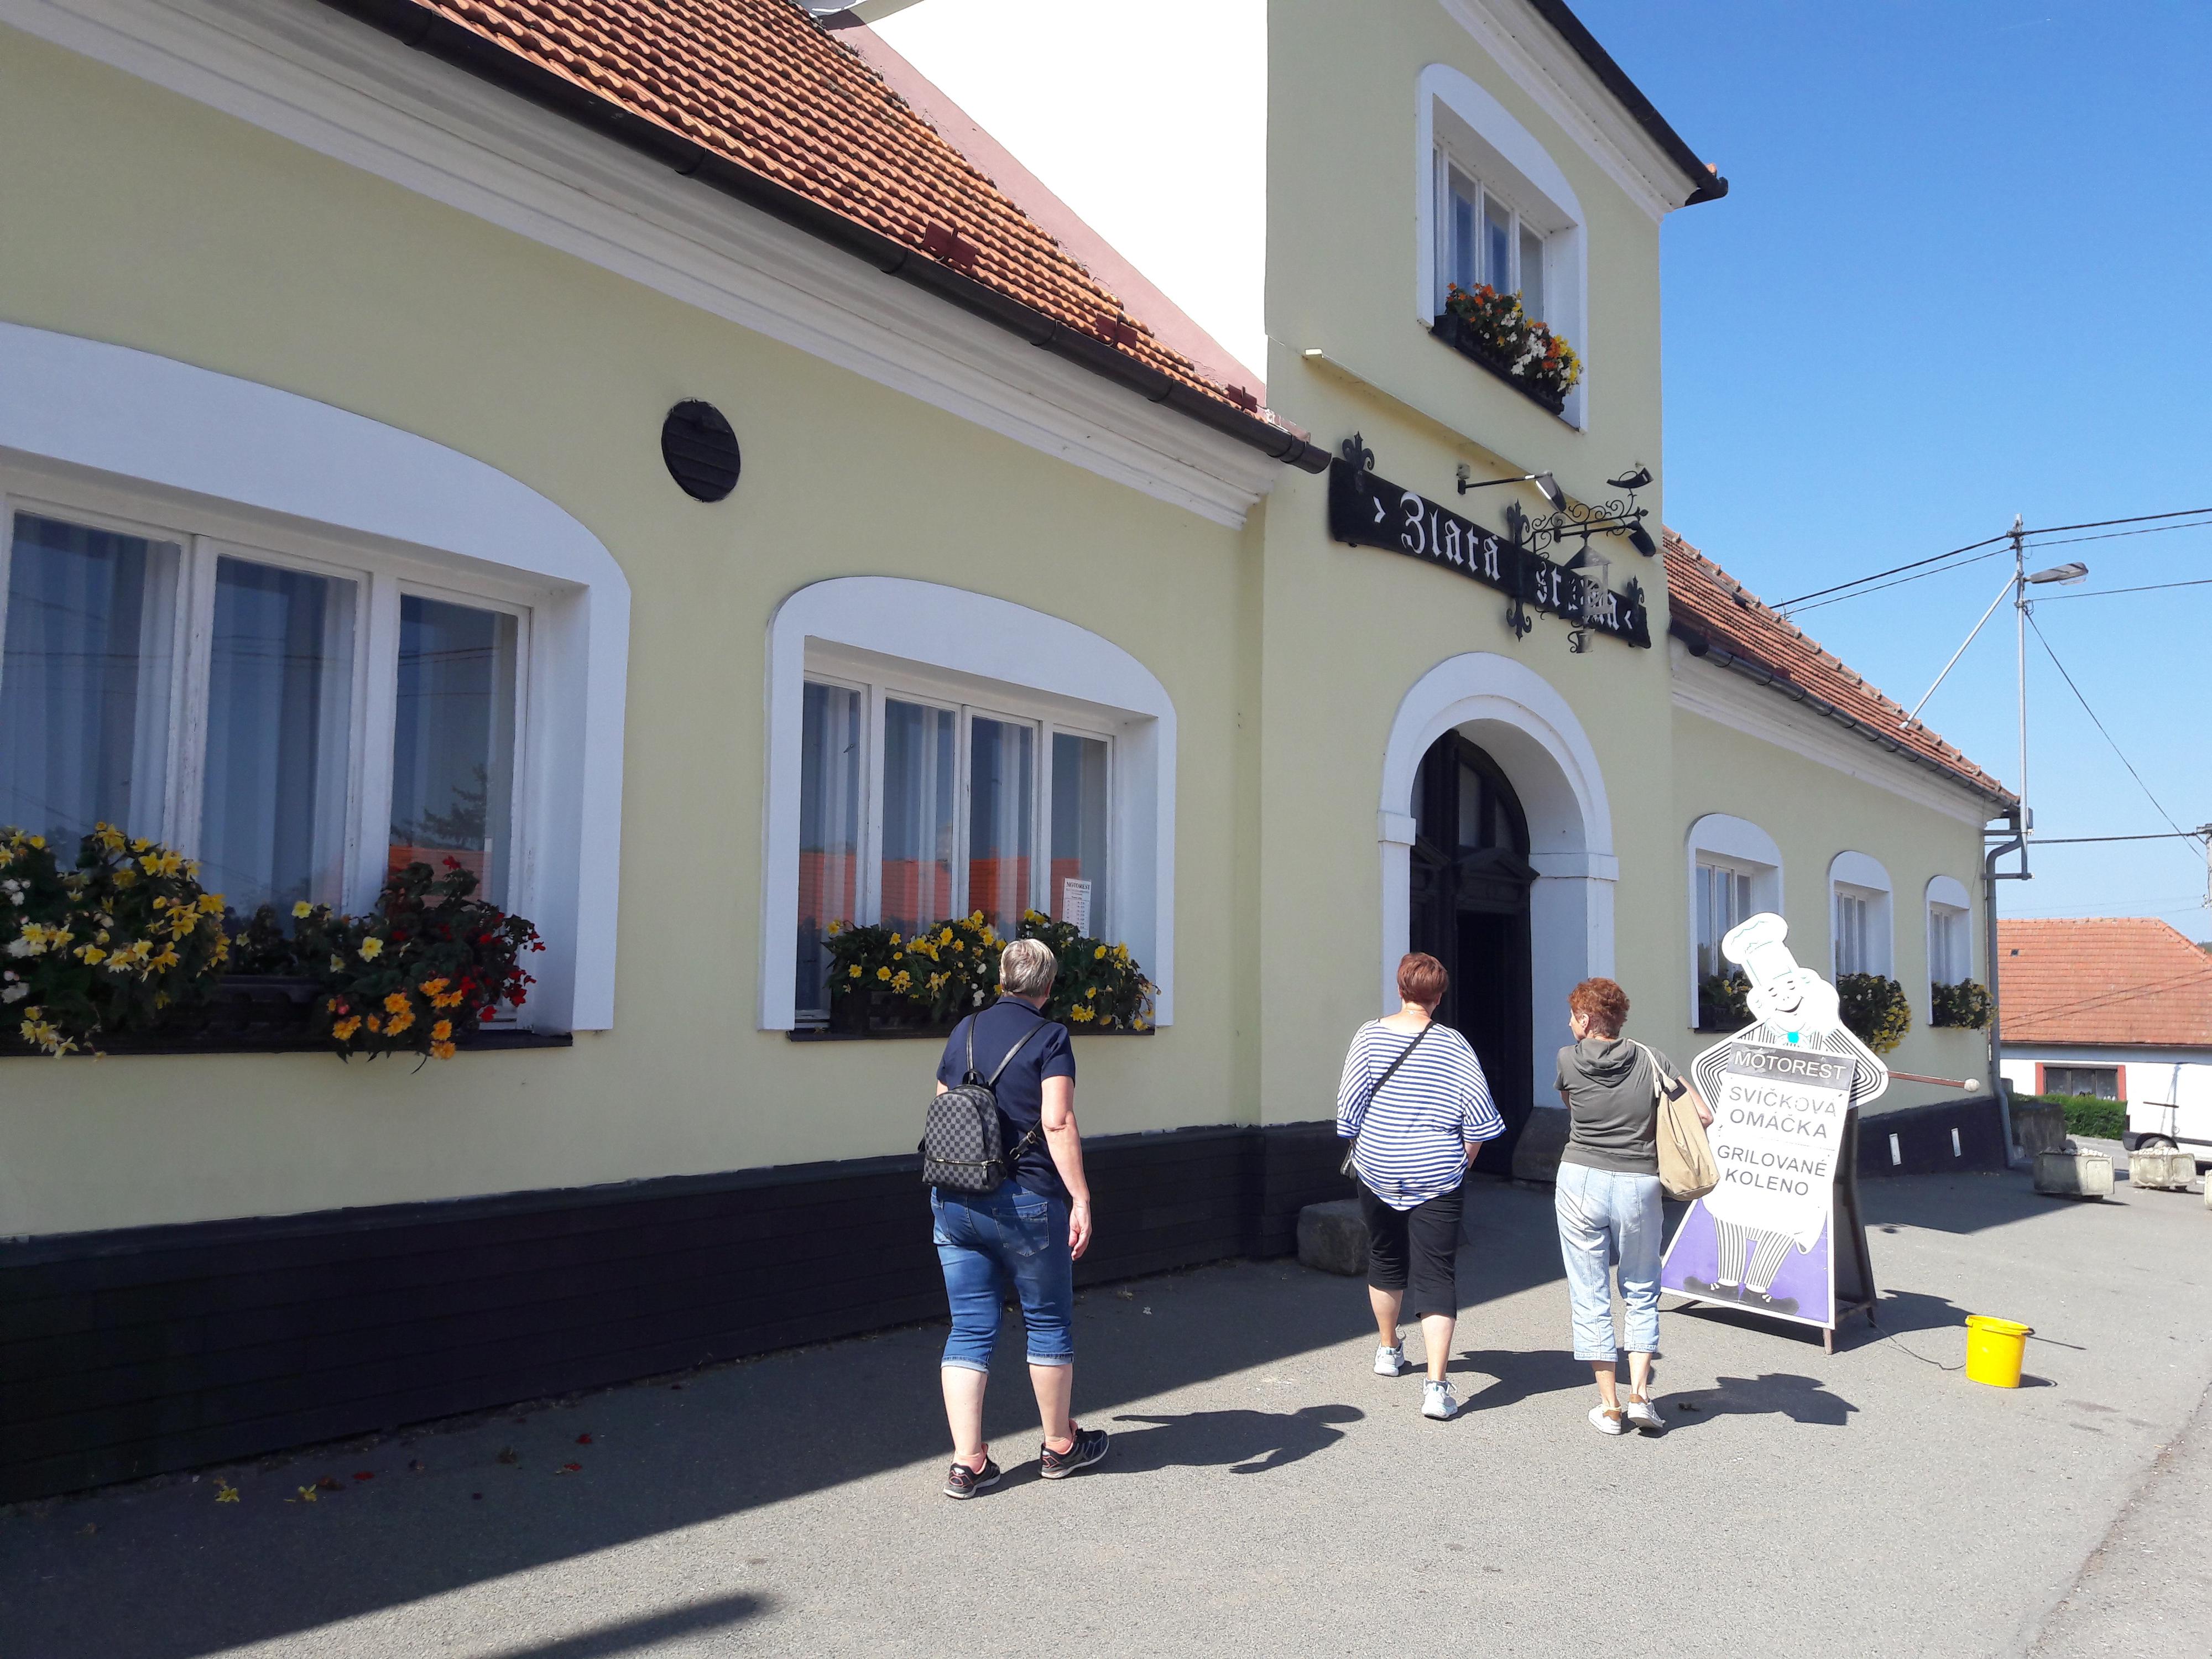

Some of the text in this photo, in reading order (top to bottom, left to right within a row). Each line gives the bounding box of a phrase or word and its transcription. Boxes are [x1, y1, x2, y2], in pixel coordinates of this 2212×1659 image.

[1400, 491, 1501, 581] Zlatá
[1066, 881, 1090, 890] MOTOREST
[1734, 1050, 1846, 1080] MOTOREST
[1729, 1086, 1837, 1117] SVÍČKOVÁ
[1730, 1109, 1827, 1138] OMÁČKA
[1717, 1145, 1827, 1177] GRILOVANÉ
[1725, 1168, 1808, 1196] KOLENO
